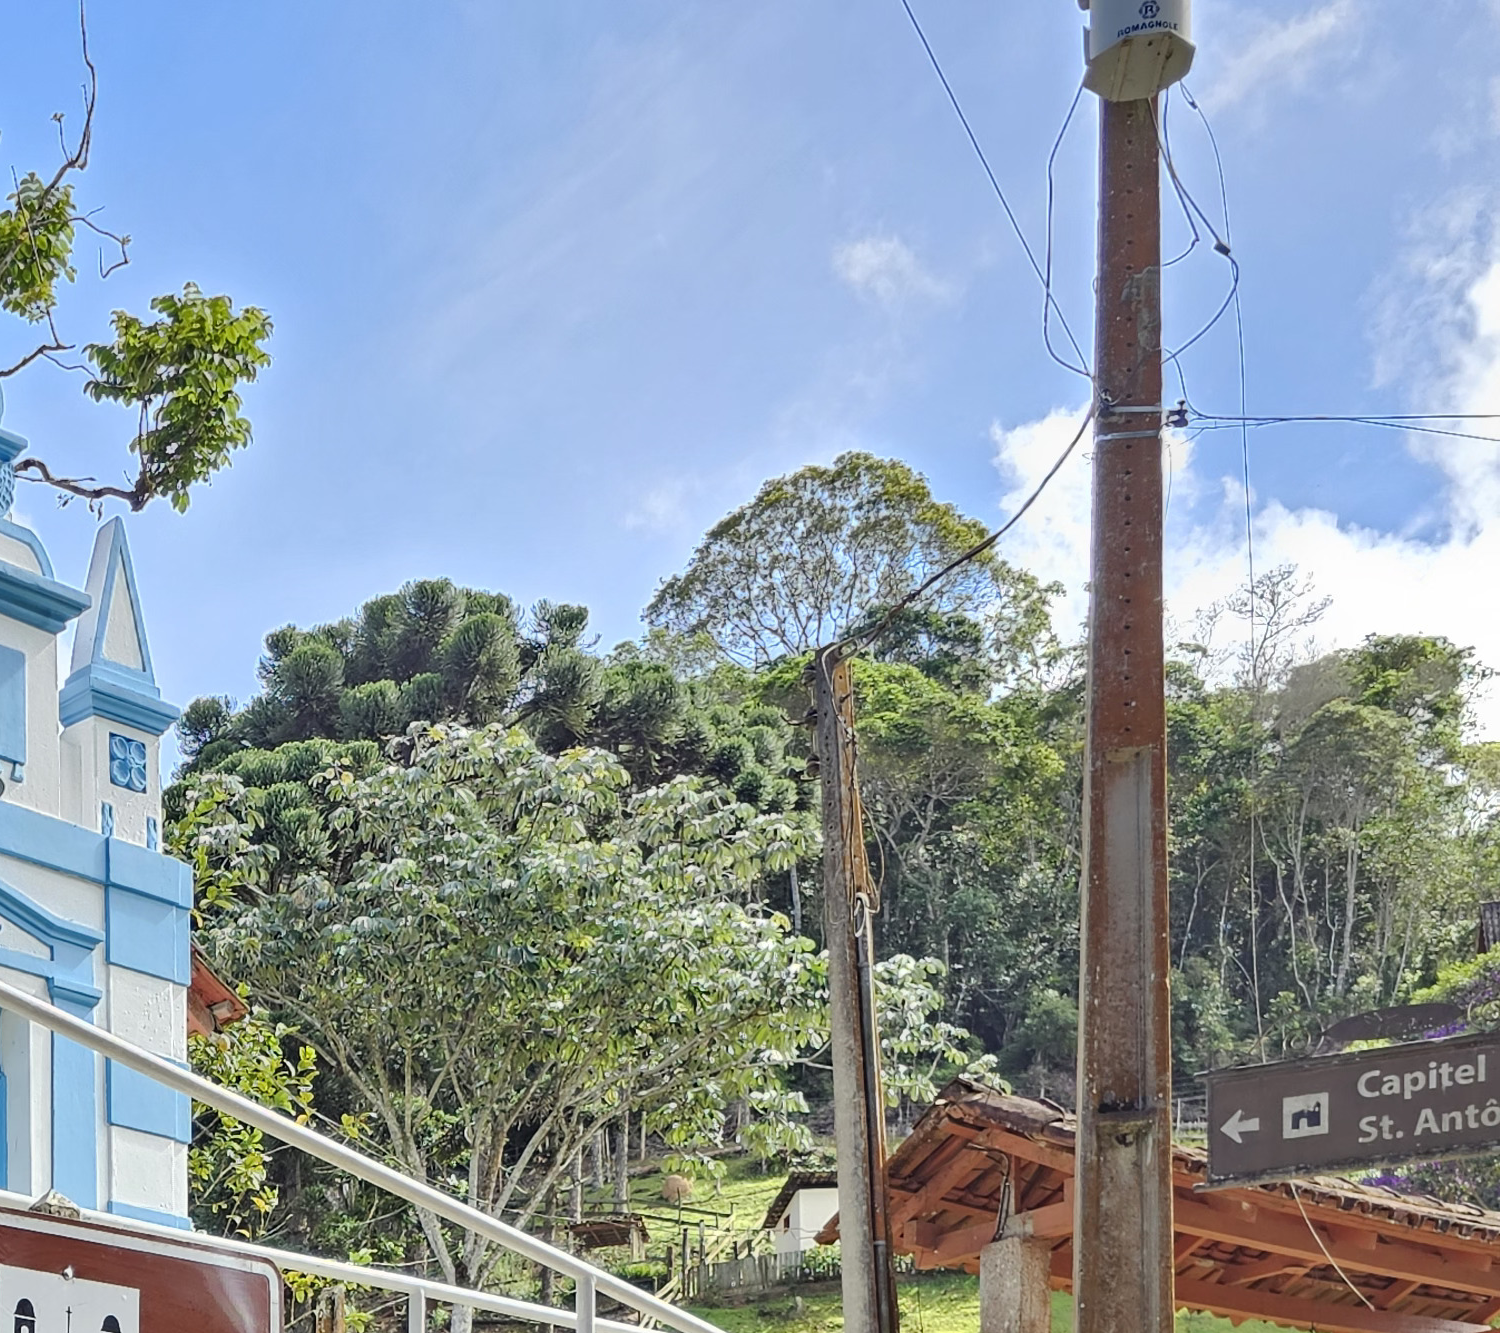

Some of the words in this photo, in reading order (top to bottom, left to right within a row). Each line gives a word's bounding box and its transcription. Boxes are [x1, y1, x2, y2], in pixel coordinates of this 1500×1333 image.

[1117, 20, 1178, 38] ROMAGNOLE
[1357, 1054, 1486, 1100] Capitel
[1358, 1115, 1404, 1143] St.
